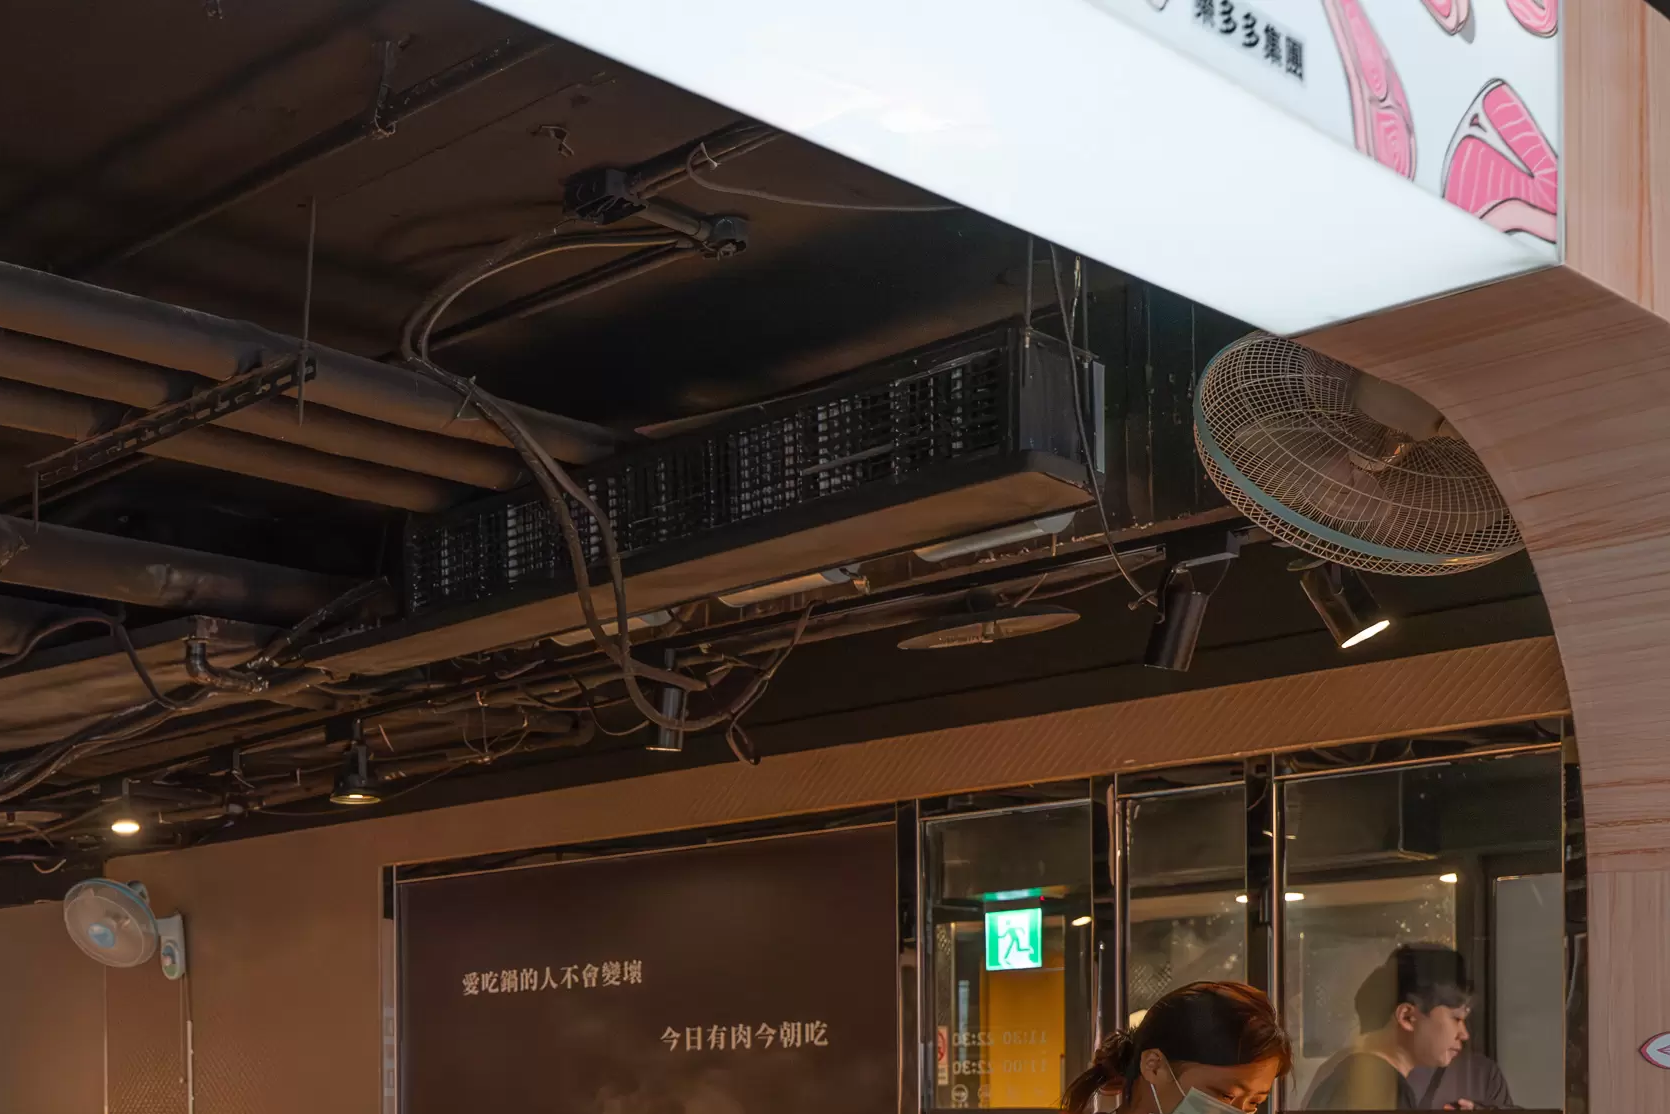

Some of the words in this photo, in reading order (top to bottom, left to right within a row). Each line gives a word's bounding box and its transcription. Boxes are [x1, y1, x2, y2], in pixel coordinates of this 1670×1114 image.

[462, 960, 642, 996] 愛吃鍋的人不會變壞
[660, 1020, 829, 1051] 今日有肉今朝吃
